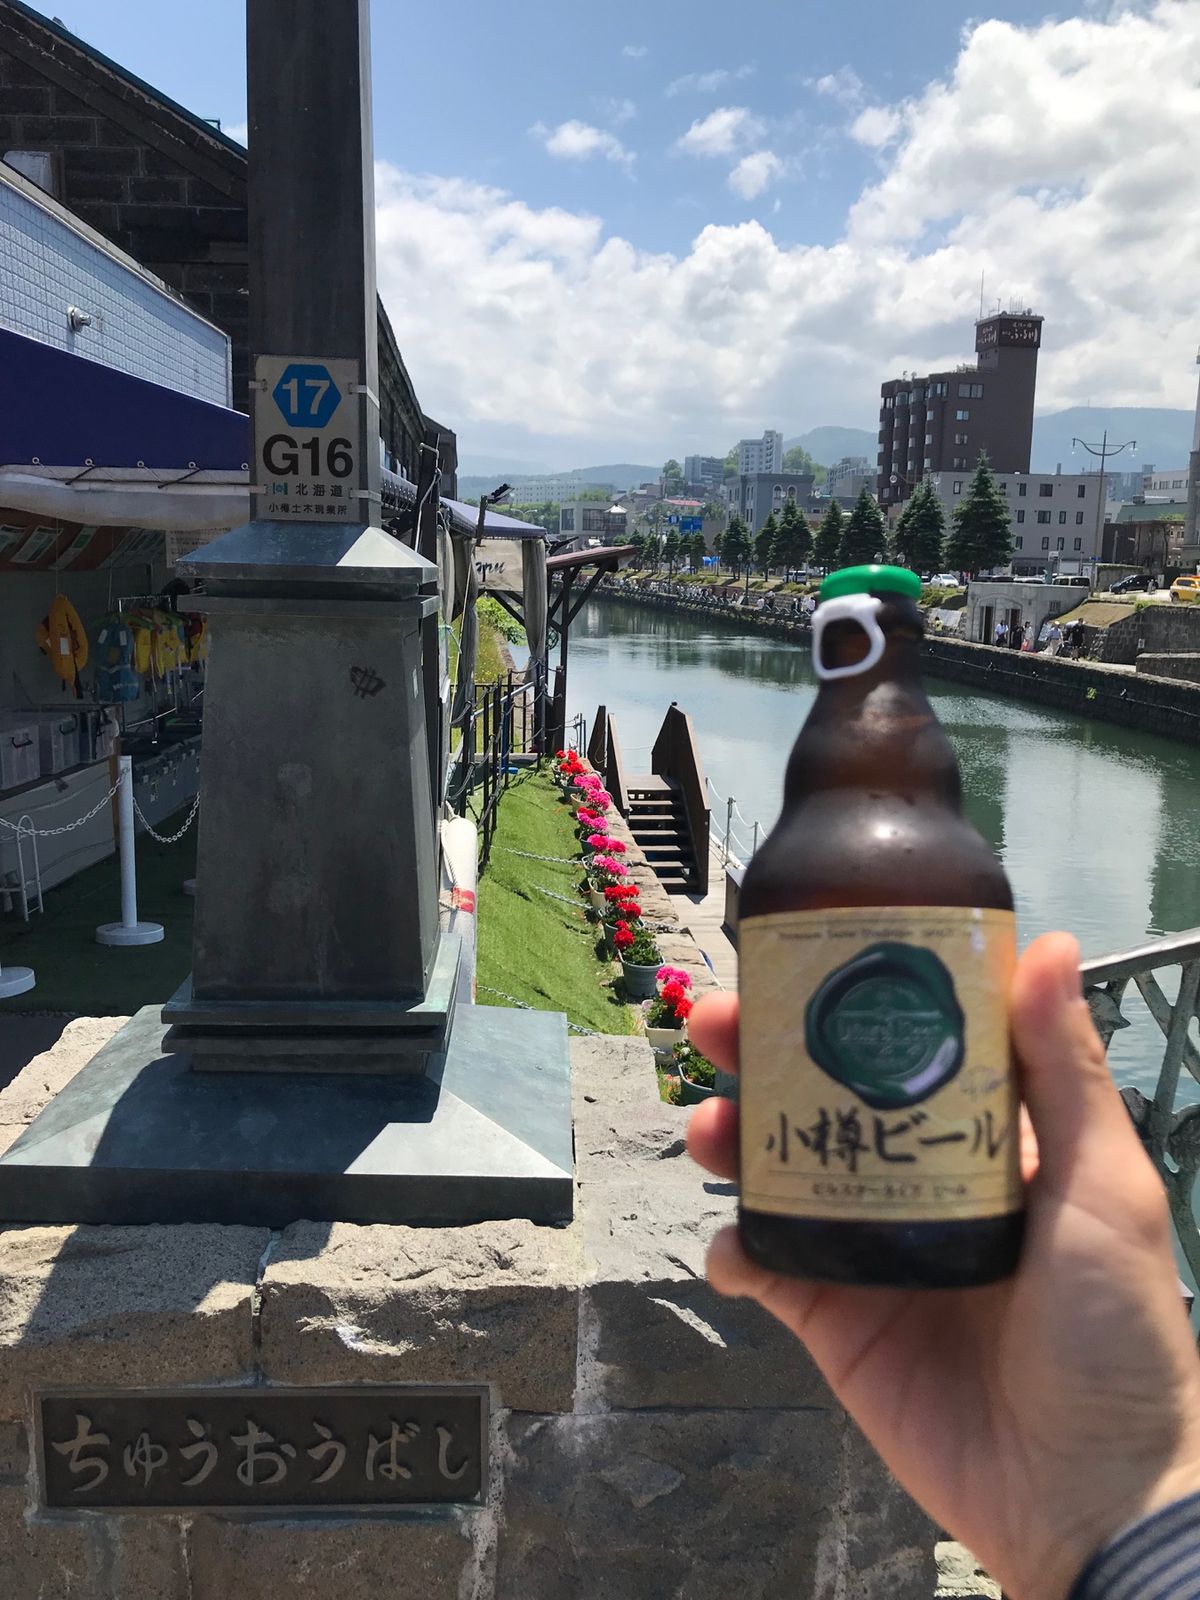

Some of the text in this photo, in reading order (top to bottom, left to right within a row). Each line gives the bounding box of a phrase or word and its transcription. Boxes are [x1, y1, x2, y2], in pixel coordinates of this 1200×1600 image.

[281, 377, 331, 415] 17
[262, 433, 354, 478] G16
[295, 483, 343, 498] 北海道
[765, 1105, 1003, 1173] 小樽ビール
[50, 1412, 470, 1493] ちゅうおうばし
